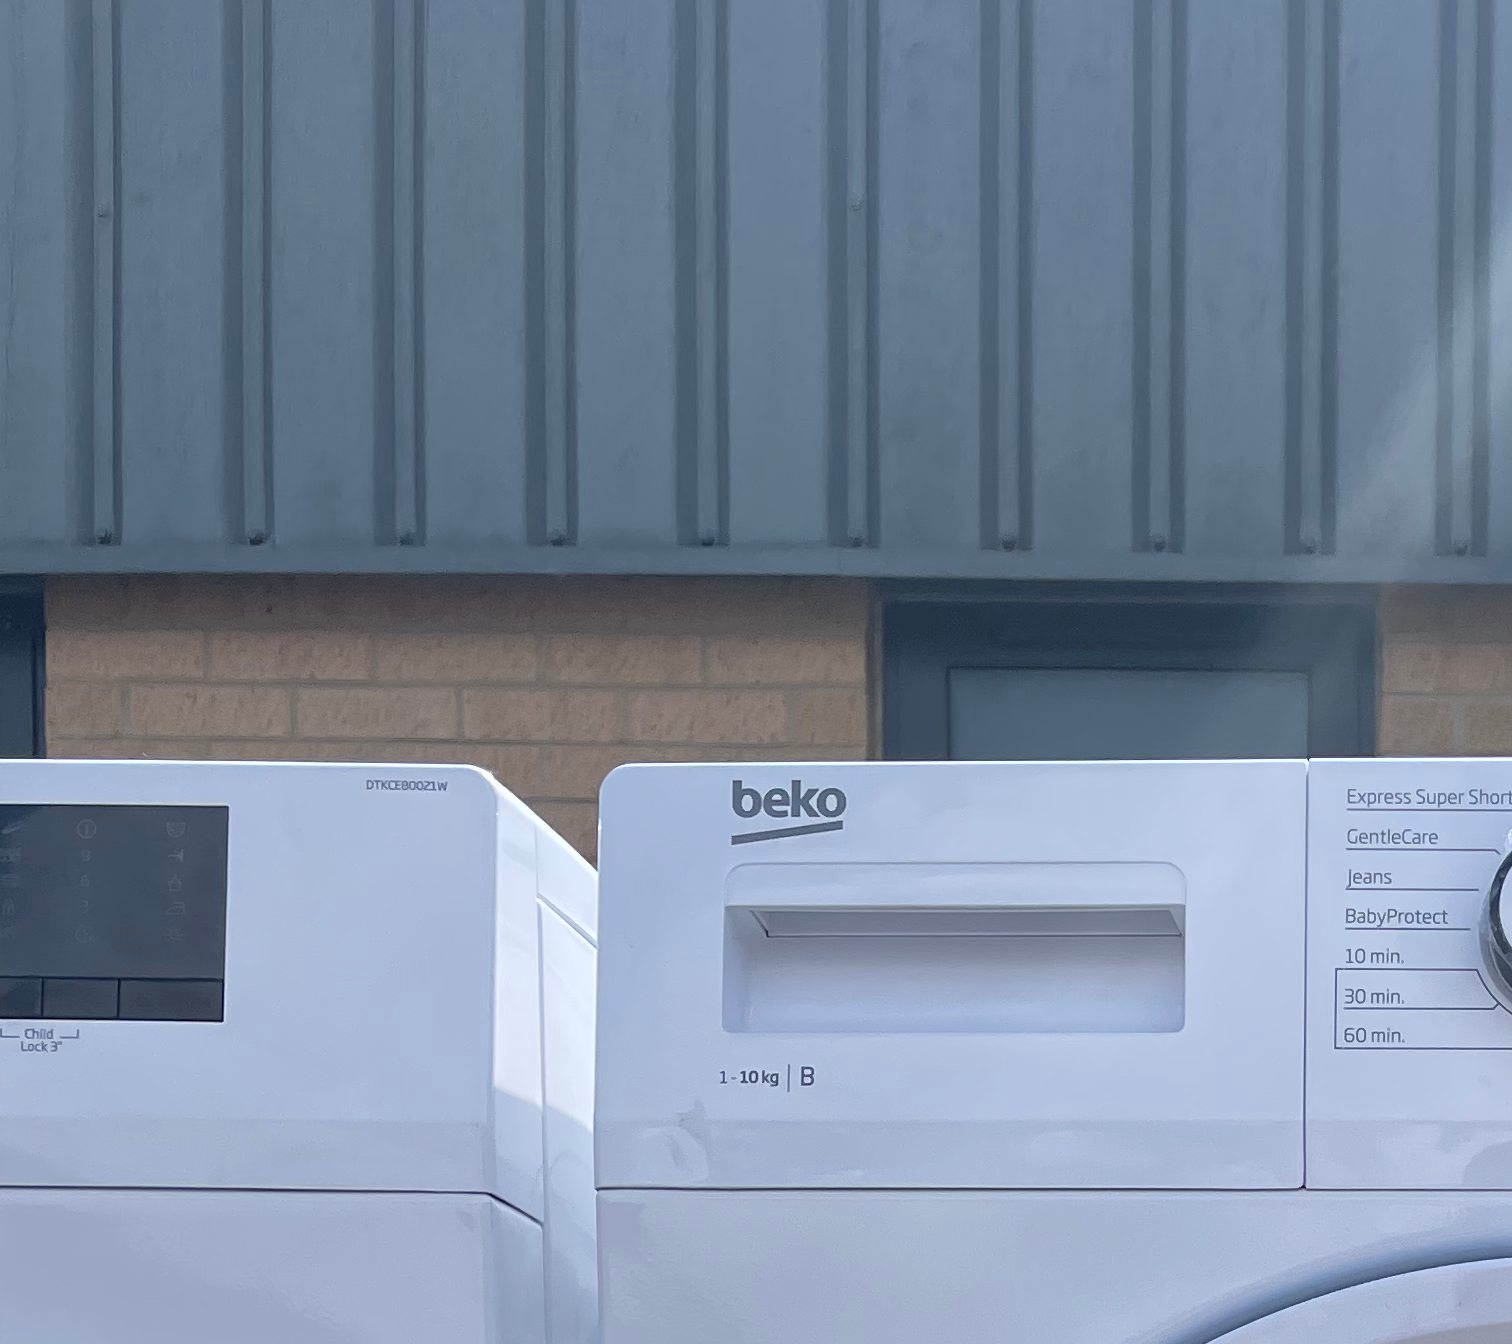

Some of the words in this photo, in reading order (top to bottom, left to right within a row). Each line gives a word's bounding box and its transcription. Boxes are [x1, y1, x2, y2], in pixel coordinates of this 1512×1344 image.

[732, 780, 846, 818] beko
[1347, 789, 1411, 807] Express
[1415, 789, 1464, 807] Super
[1347, 829, 1438, 844] GentleCare
[1346, 869, 1392, 887] Jeans
[1345, 908, 1448, 927] BabyProtect
[1346, 949, 1365, 963] 10
[1371, 948, 1404, 964] min.
[1345, 989, 1366, 1004] 30
[1371, 988, 1404, 1004] min.
[24, 1028, 53, 1039] Child
[1344, 1028, 1366, 1043] 60
[1371, 1028, 1405, 1043] min.
[20, 1041, 48, 1052] Lock
[801, 1067, 814, 1086] B
